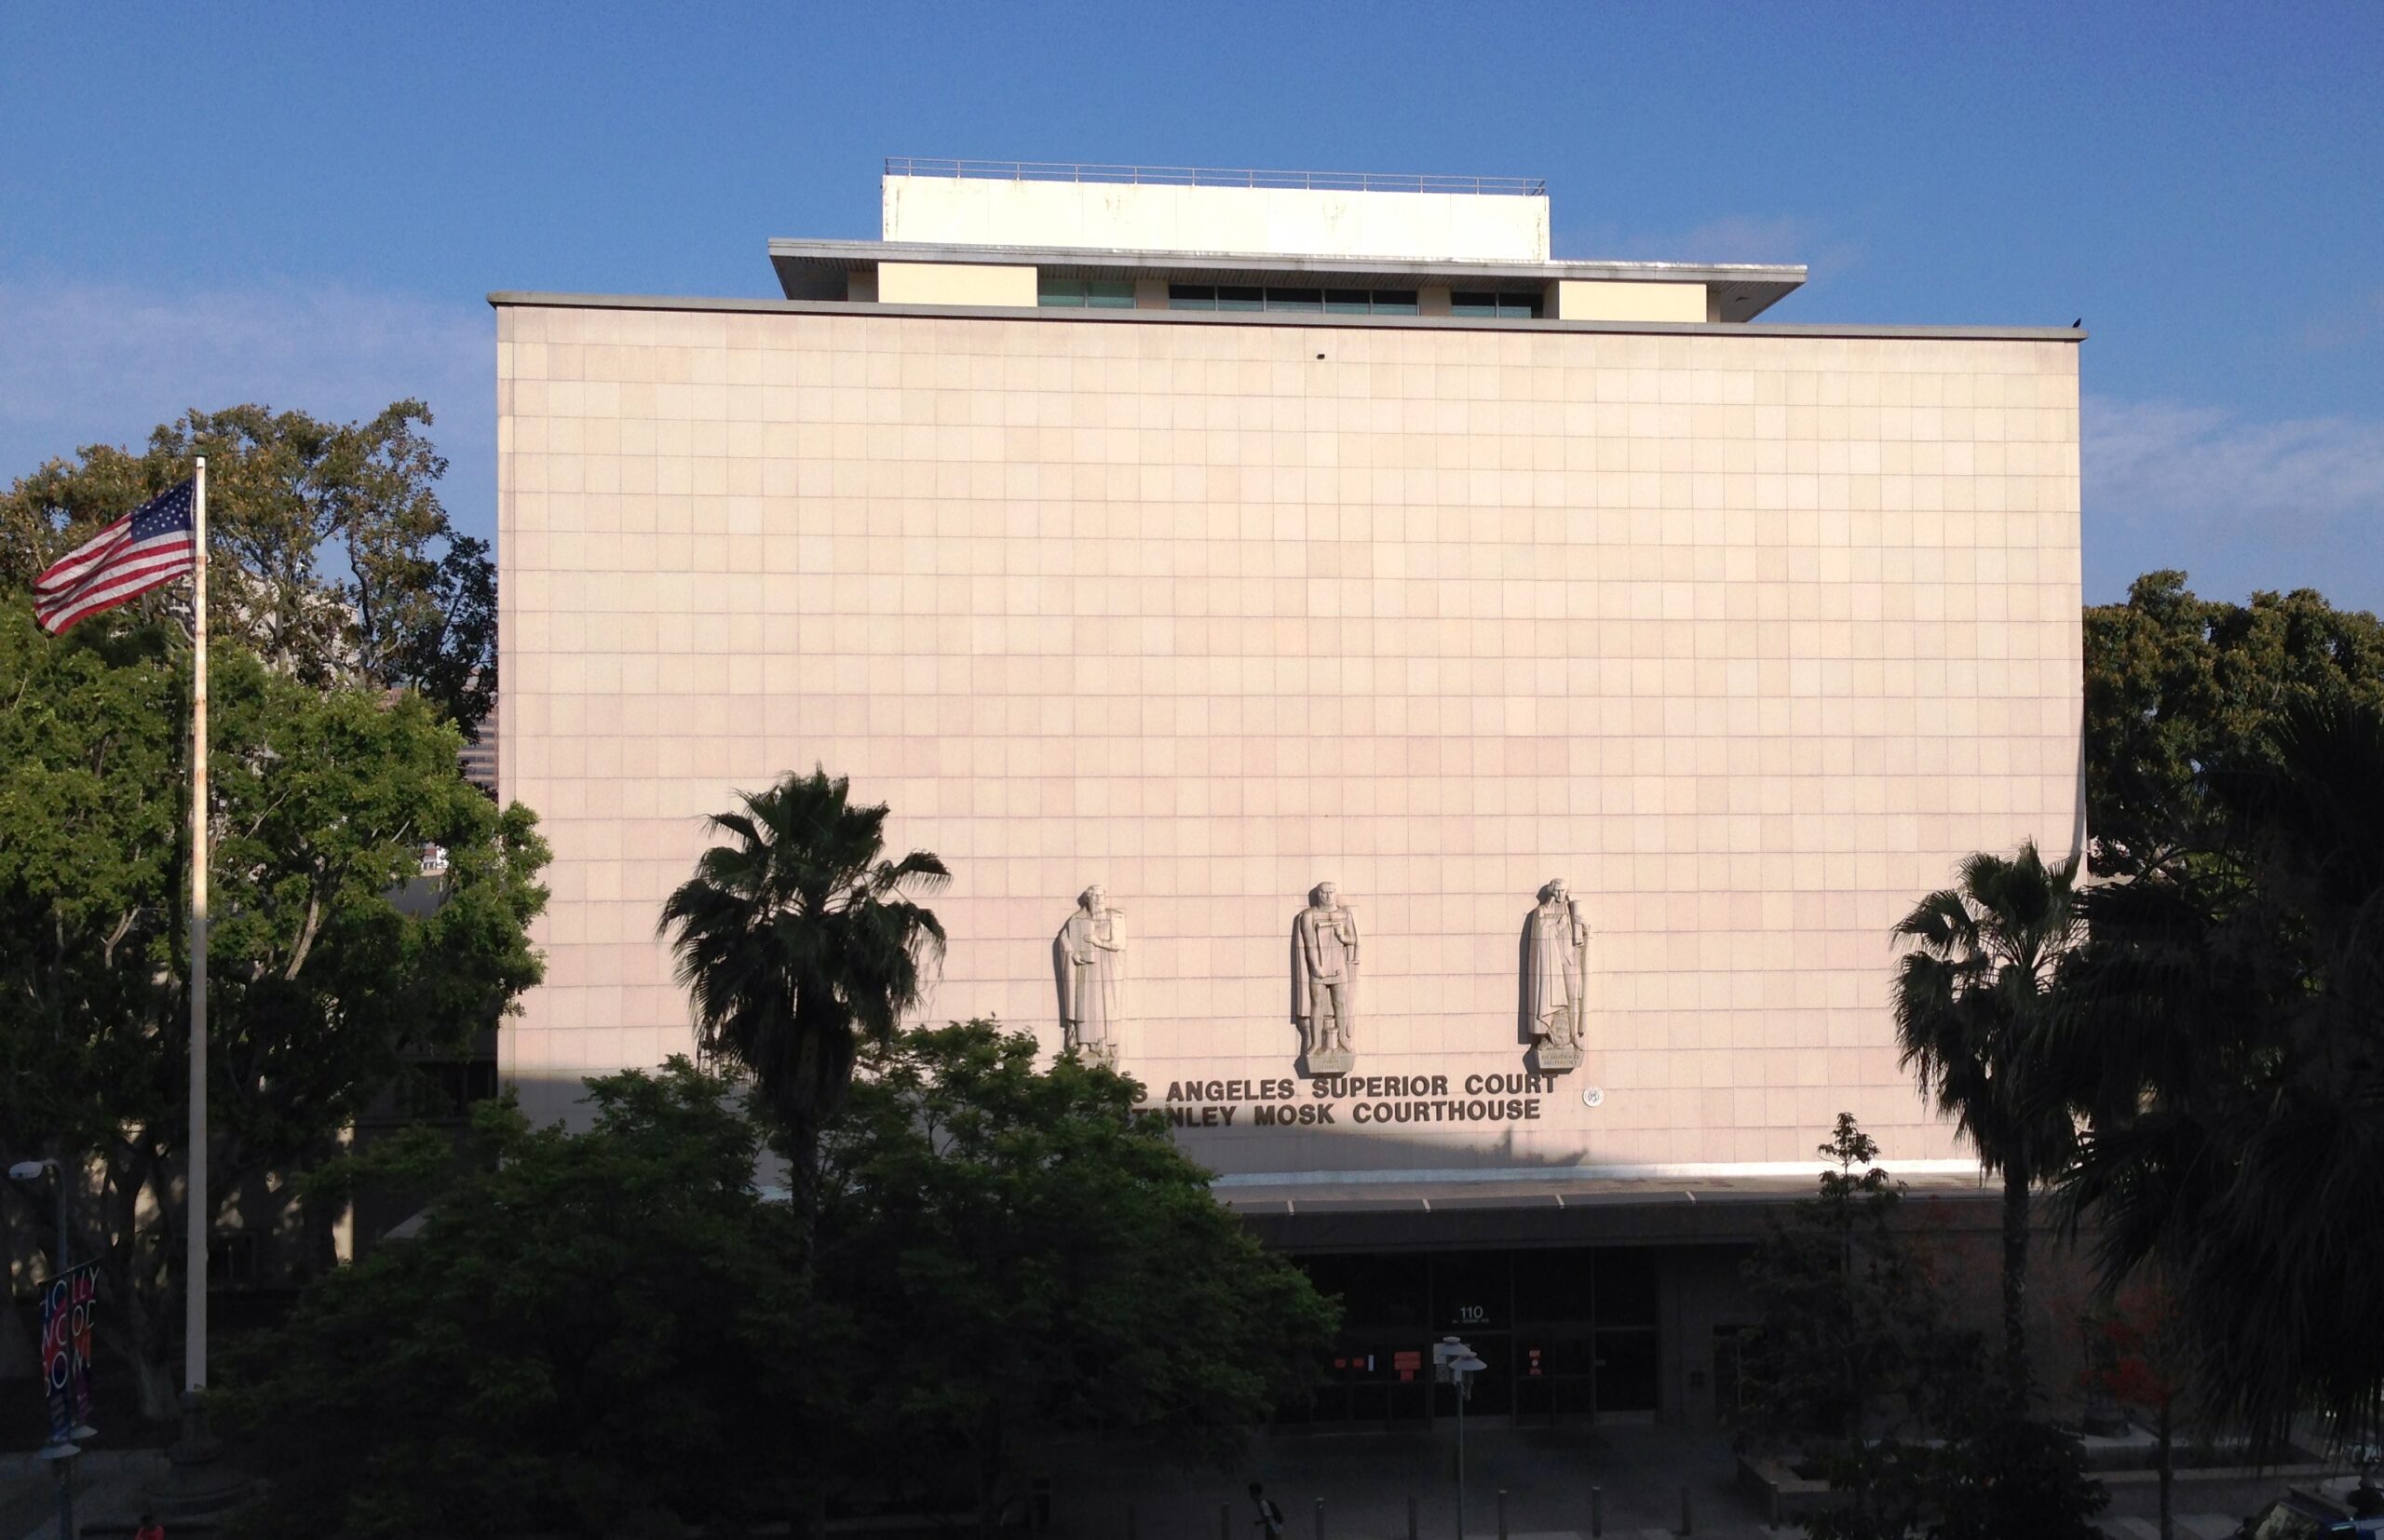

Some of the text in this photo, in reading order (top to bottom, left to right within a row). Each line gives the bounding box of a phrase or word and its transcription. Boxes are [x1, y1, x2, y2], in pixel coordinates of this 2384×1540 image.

[1166, 1078, 1295, 1103] ANGELES
[1311, 1075, 1448, 1099] SUPERIOR
[1465, 1074, 1557, 1095] COURT
[1253, 1103, 1335, 1126] MOSK
[1352, 1099, 1541, 1124] COURTHOUSE
[1459, 1305, 1483, 1318] 110
